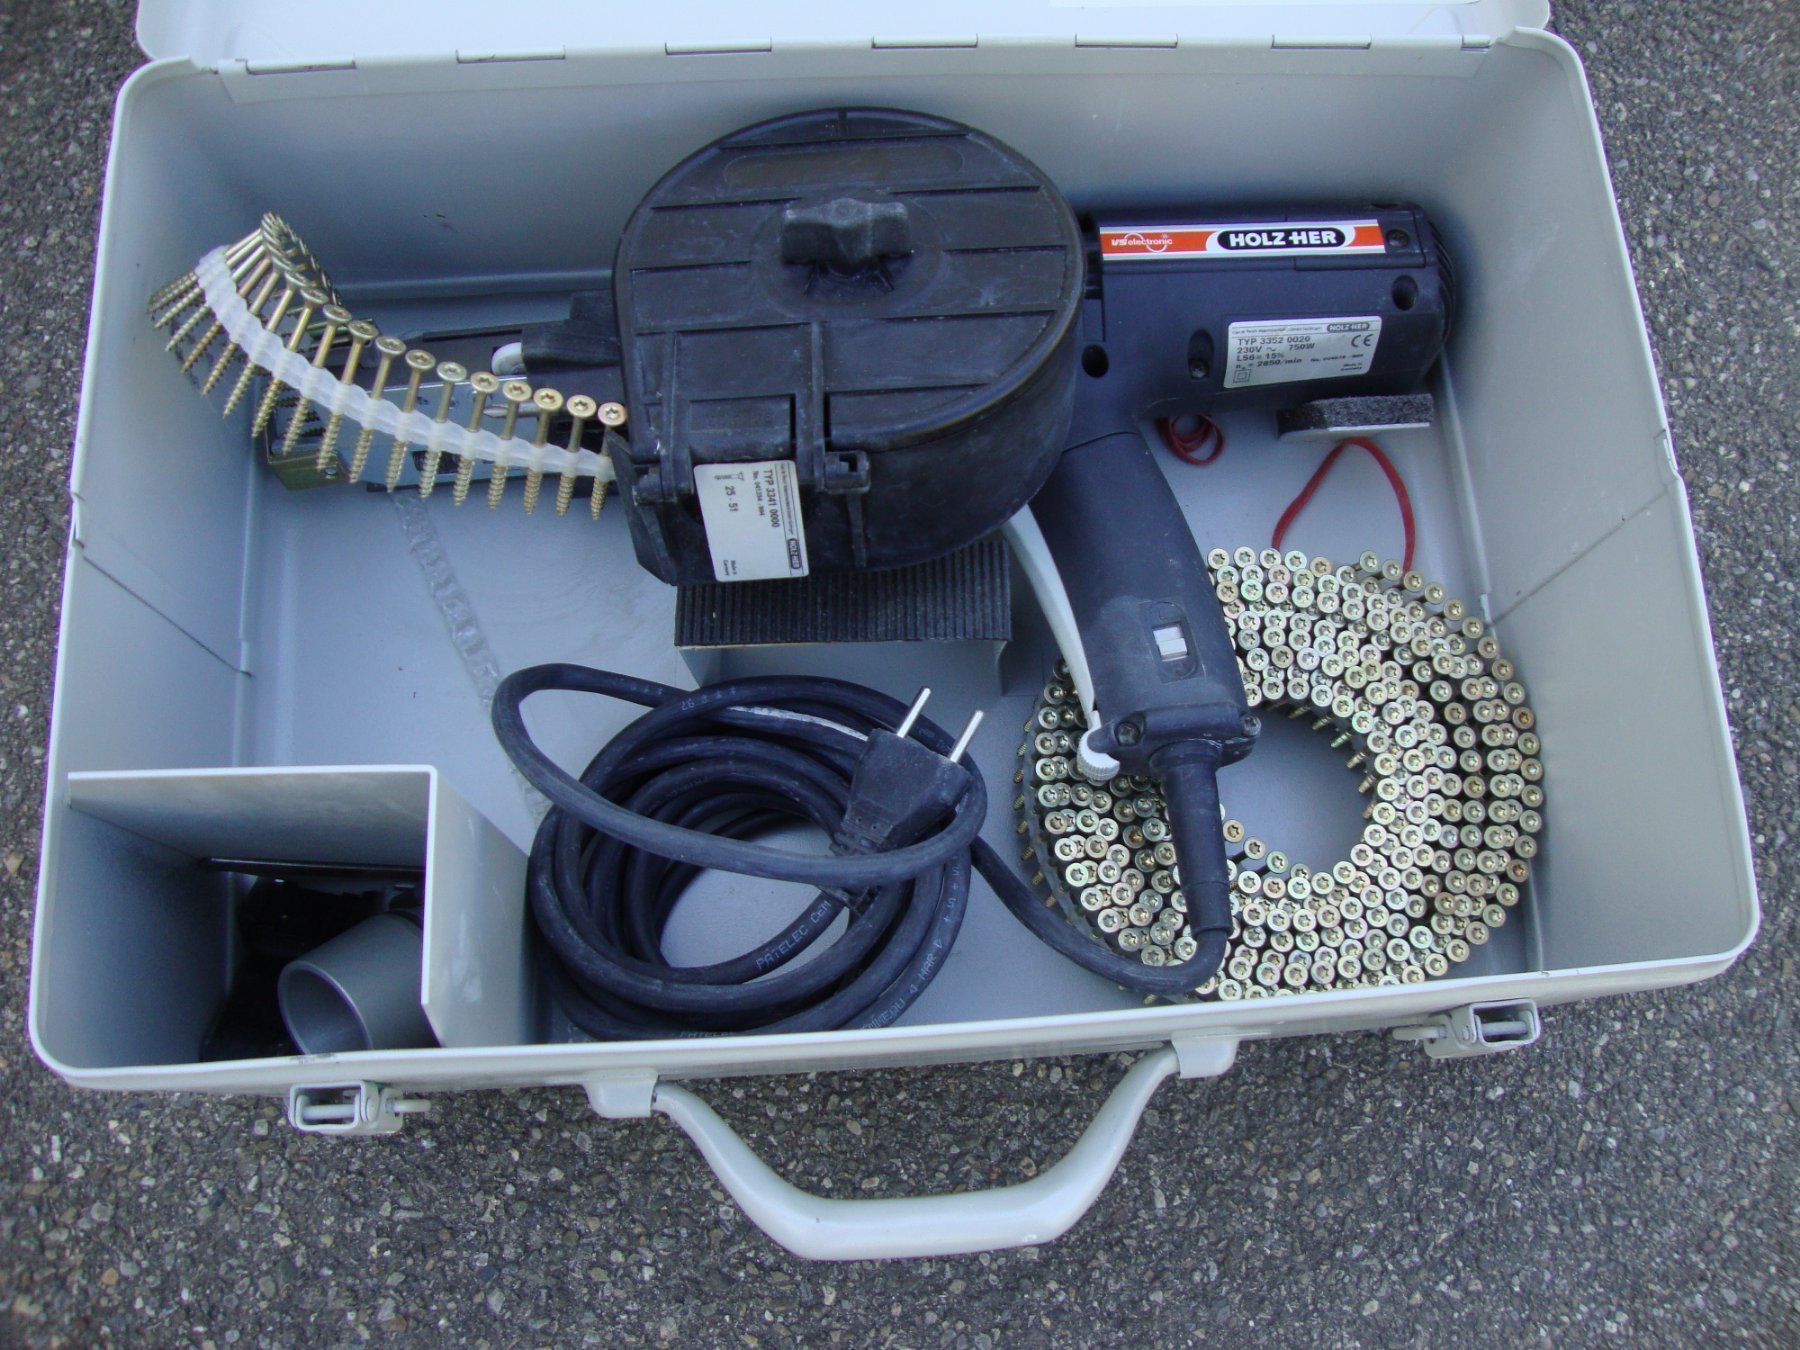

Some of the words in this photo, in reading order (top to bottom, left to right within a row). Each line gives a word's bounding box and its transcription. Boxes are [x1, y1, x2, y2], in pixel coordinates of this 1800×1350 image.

[1237, 337, 1257, 345] TYP
[1287, 335, 1311, 343] 0020
[1236, 345, 1263, 354] 230V
[1288, 342, 1316, 351] 750W
[725, 486, 736, 496] 25
[764, 469, 774, 486] TYP
[769, 508, 780, 528] 0000
[756, 926, 809, 970] PATELEC
